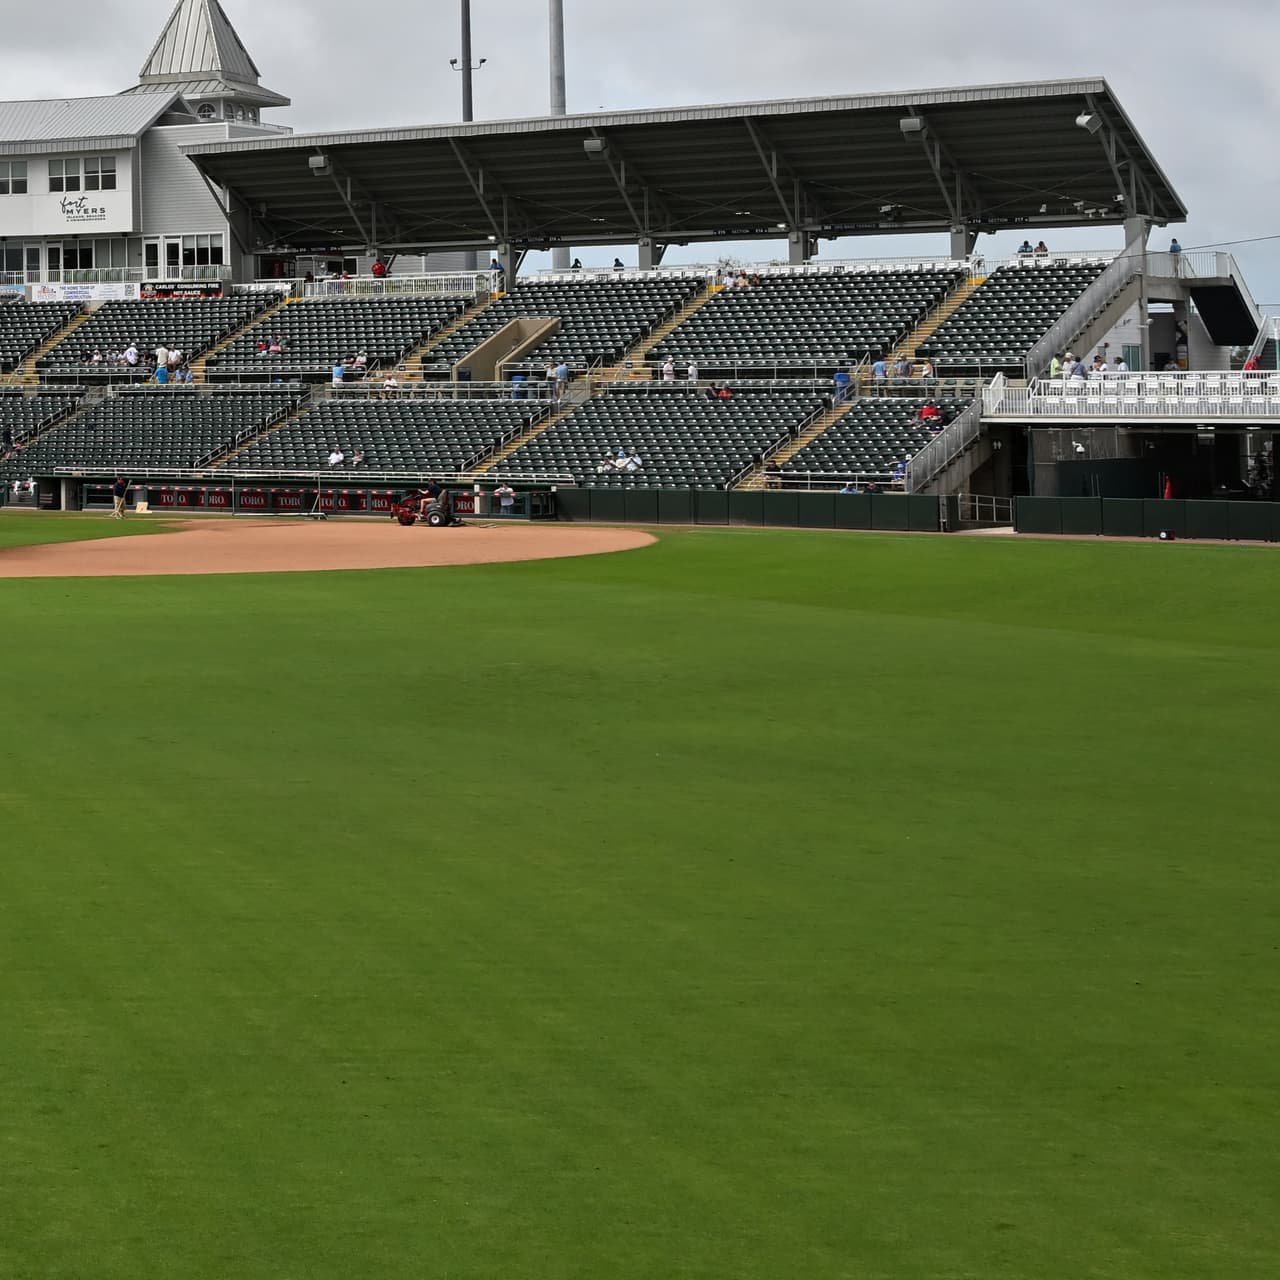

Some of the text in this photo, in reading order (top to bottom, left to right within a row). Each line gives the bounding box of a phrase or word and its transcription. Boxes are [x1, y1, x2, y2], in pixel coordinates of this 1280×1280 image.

[161, 495, 186, 503] TOO
[321, 498, 346, 507] TOO
[360, 498, 388, 508] TRO
